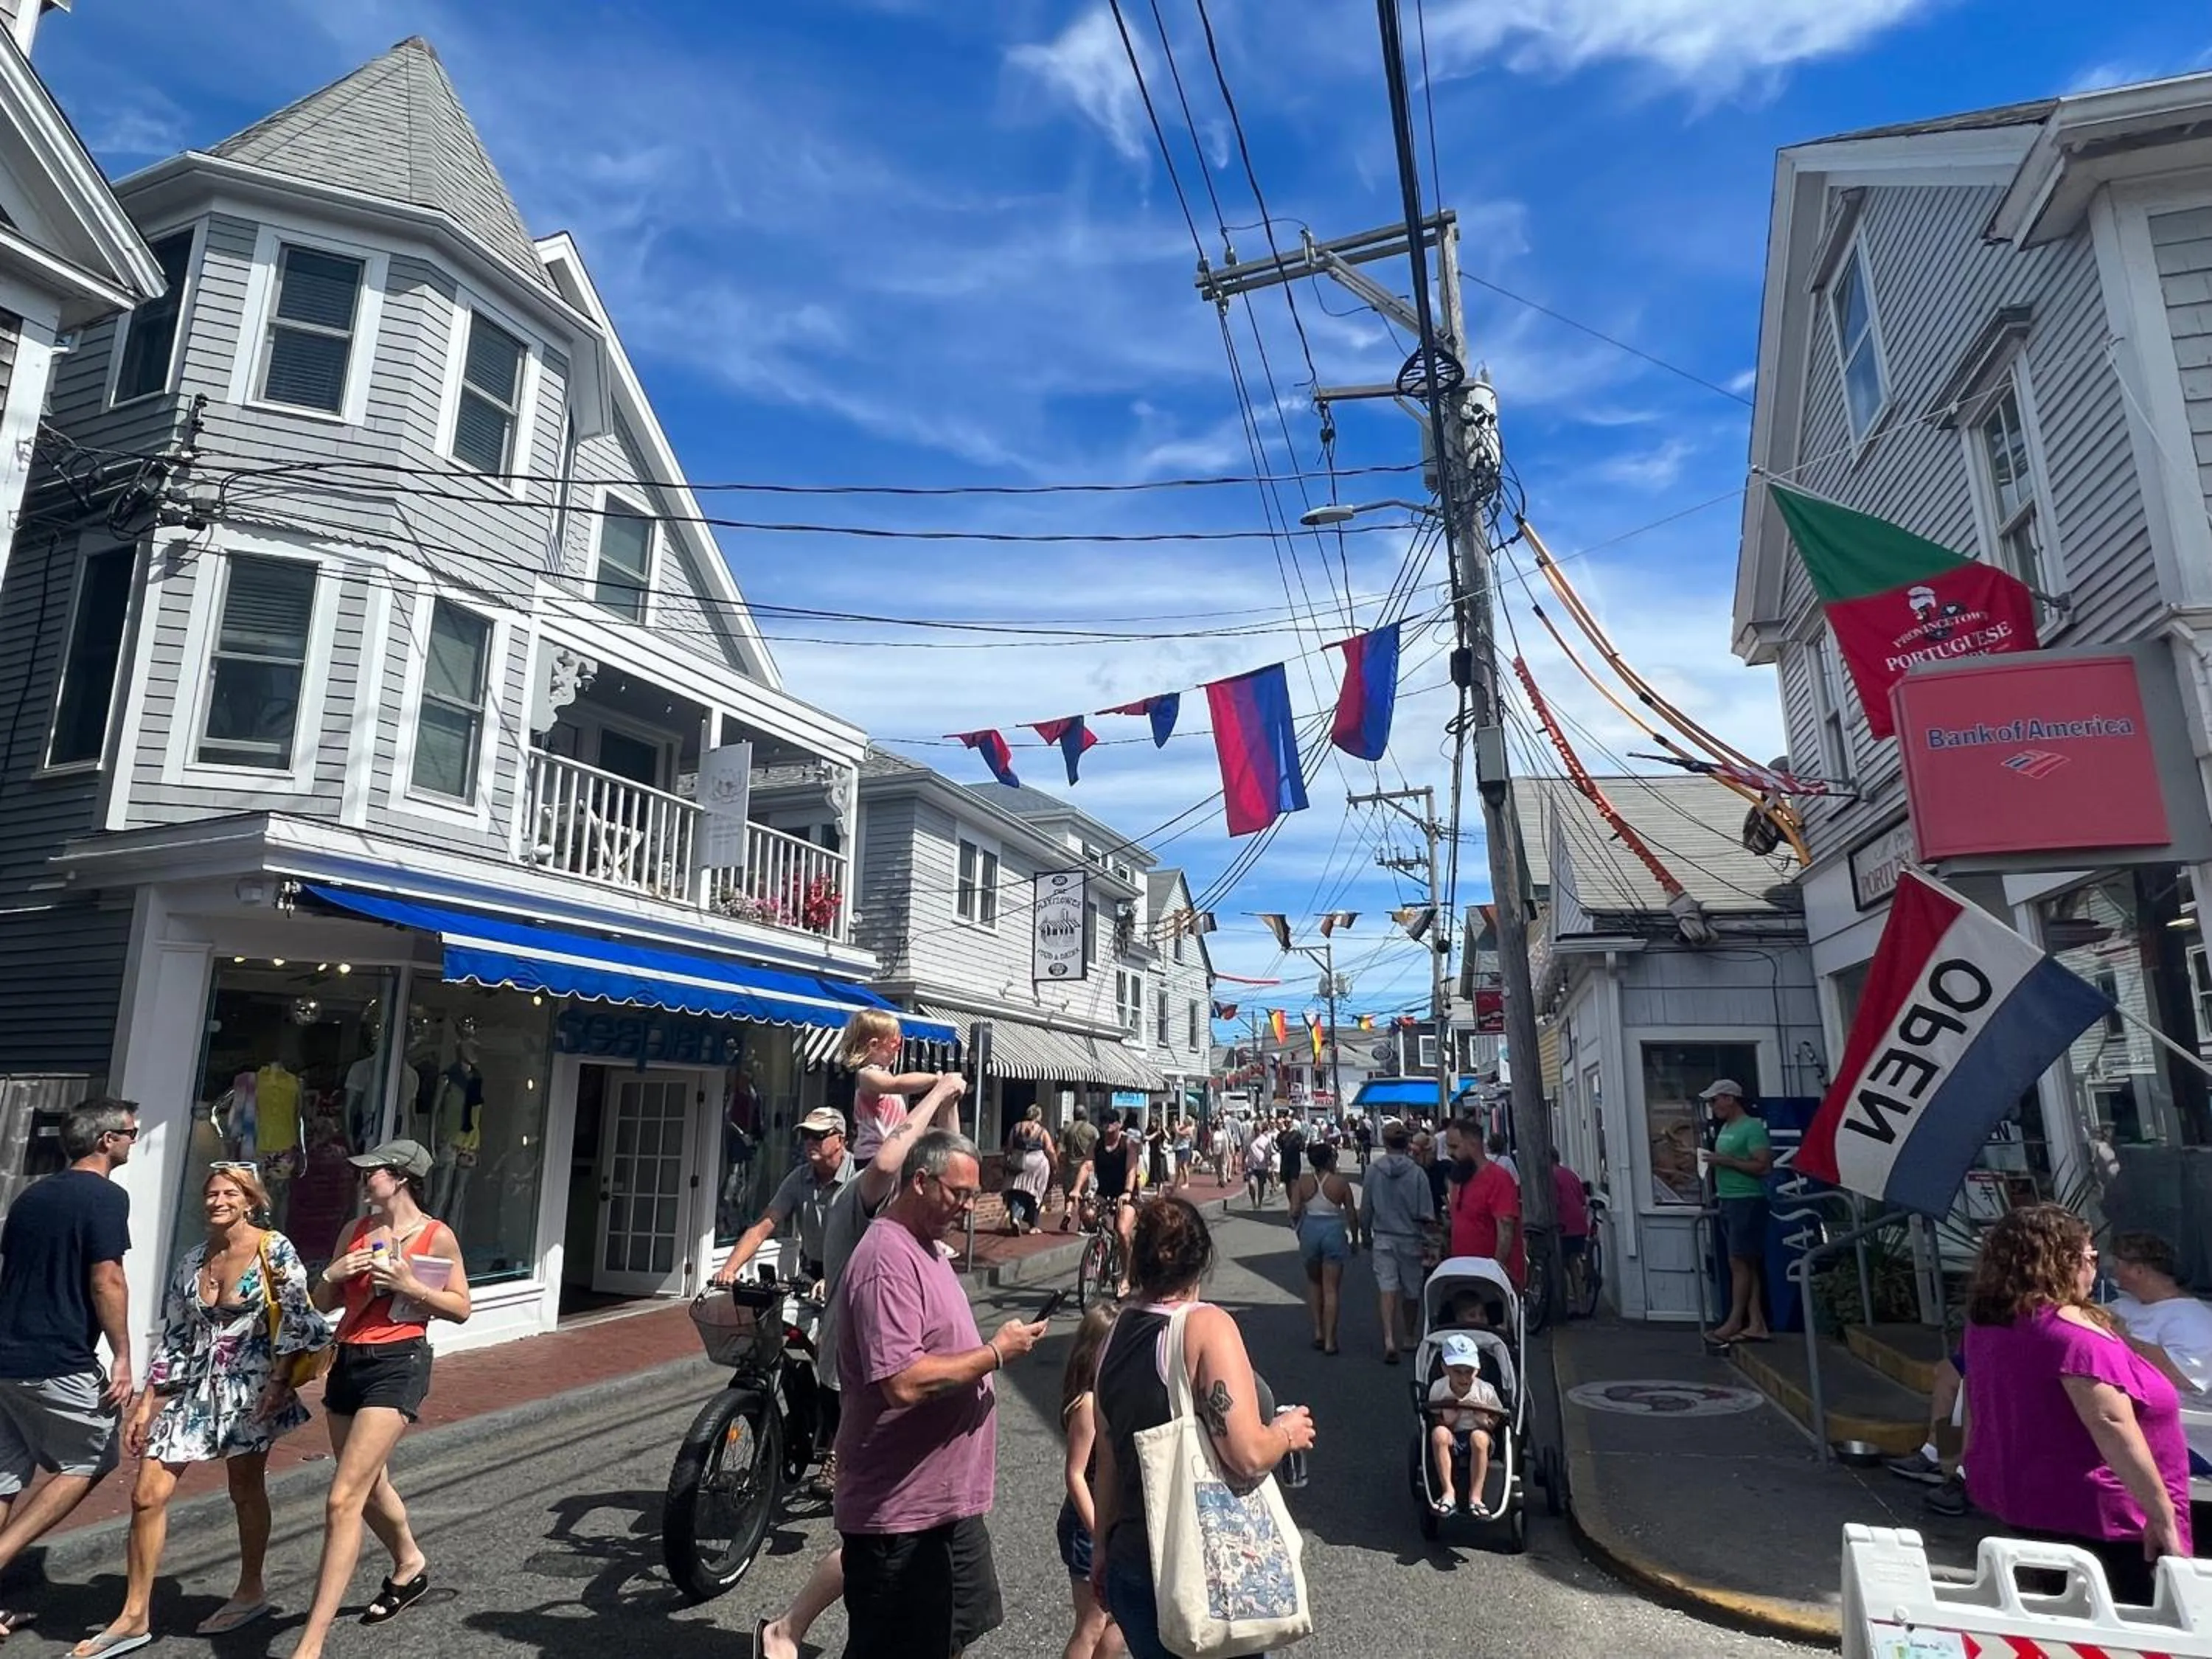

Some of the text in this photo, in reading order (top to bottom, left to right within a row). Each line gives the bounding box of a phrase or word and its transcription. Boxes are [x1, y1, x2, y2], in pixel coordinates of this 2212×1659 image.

[1885, 621, 2012, 672] PORTUGUESE
[1926, 714, 2135, 750] Bank of America
[1769, 1129, 1823, 1282] DASANI
